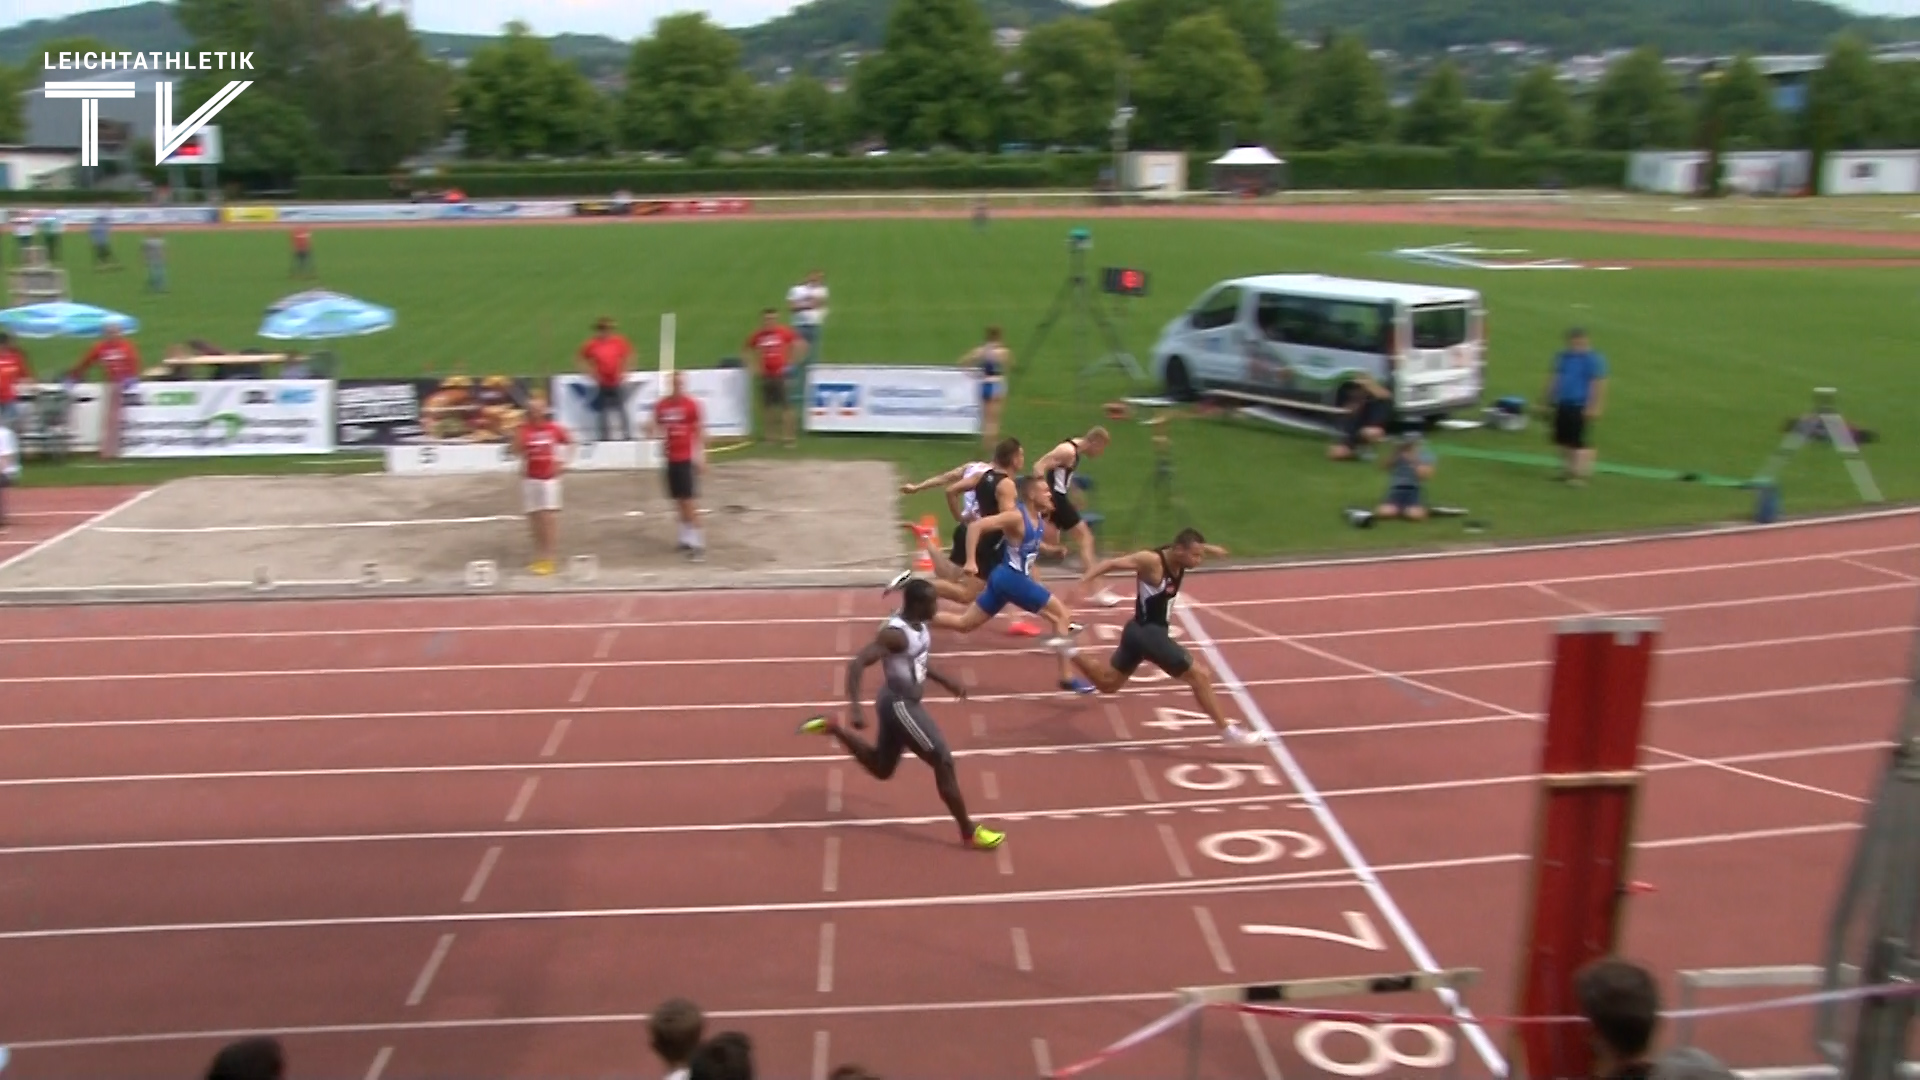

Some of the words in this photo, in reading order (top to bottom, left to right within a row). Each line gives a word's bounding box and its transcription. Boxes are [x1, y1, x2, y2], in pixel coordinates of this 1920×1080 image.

[1142, 706, 1241, 732] 4
[1164, 761, 1283, 791] 5
[1197, 828, 1326, 864] 6
[1240, 910, 1388, 952] 7
[1293, 1019, 1456, 1077] 8
